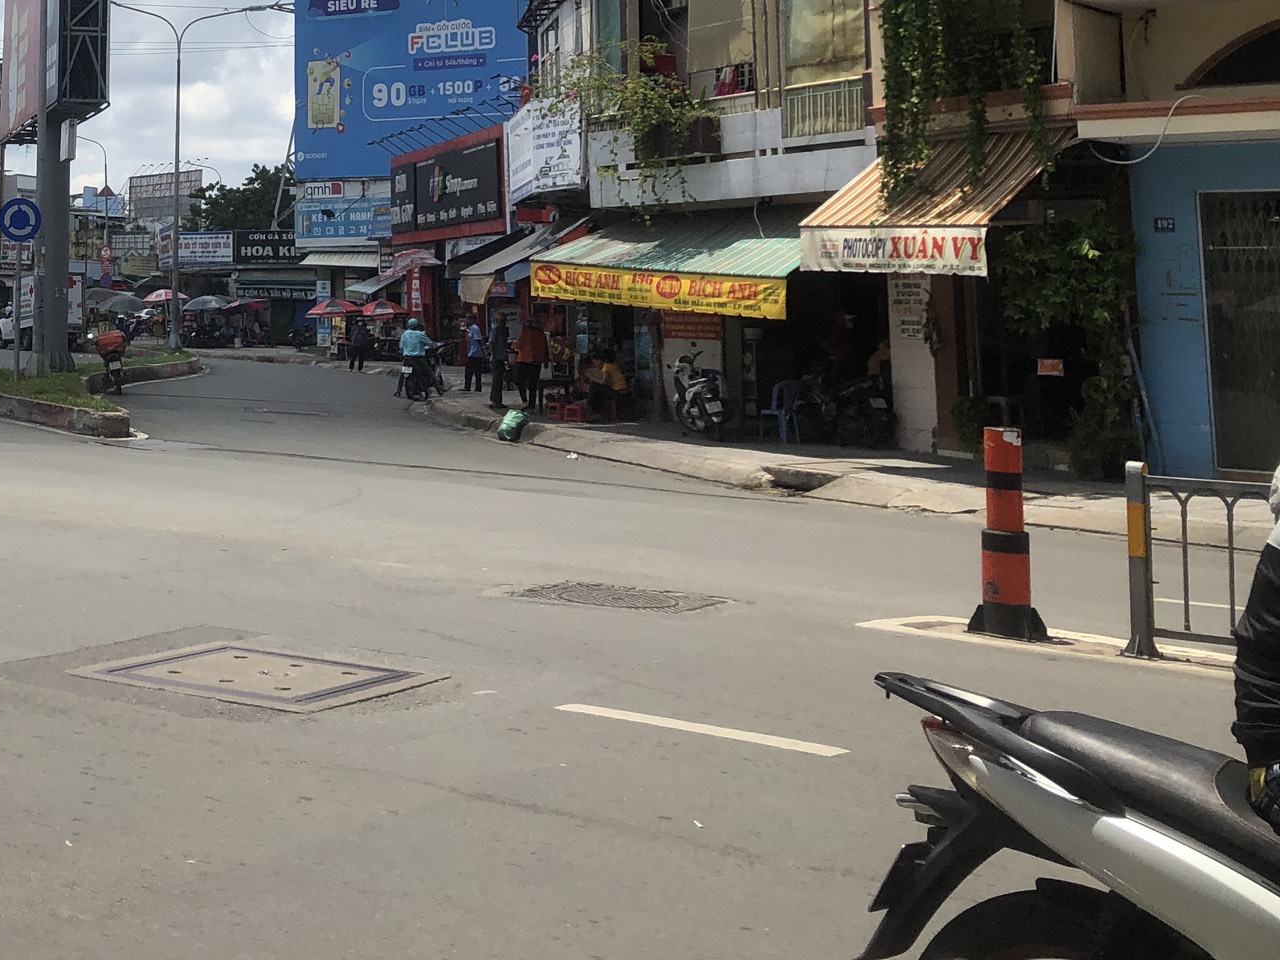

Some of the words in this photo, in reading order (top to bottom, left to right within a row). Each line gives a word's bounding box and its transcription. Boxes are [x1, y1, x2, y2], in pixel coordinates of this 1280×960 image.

[372, 81, 406, 108] 90
[408, 84, 426, 97] GB
[248, 232, 266, 240] CƠM
[281, 230, 295, 240] XỐ
[842, 237, 888, 260] PHOTOCOPY
[888, 229, 946, 261] XUÂN
[951, 236, 985, 261] VY
[594, 272, 621, 291] ANH
[687, 275, 724, 299] BÍCH
[726, 282, 759, 301] ANH
